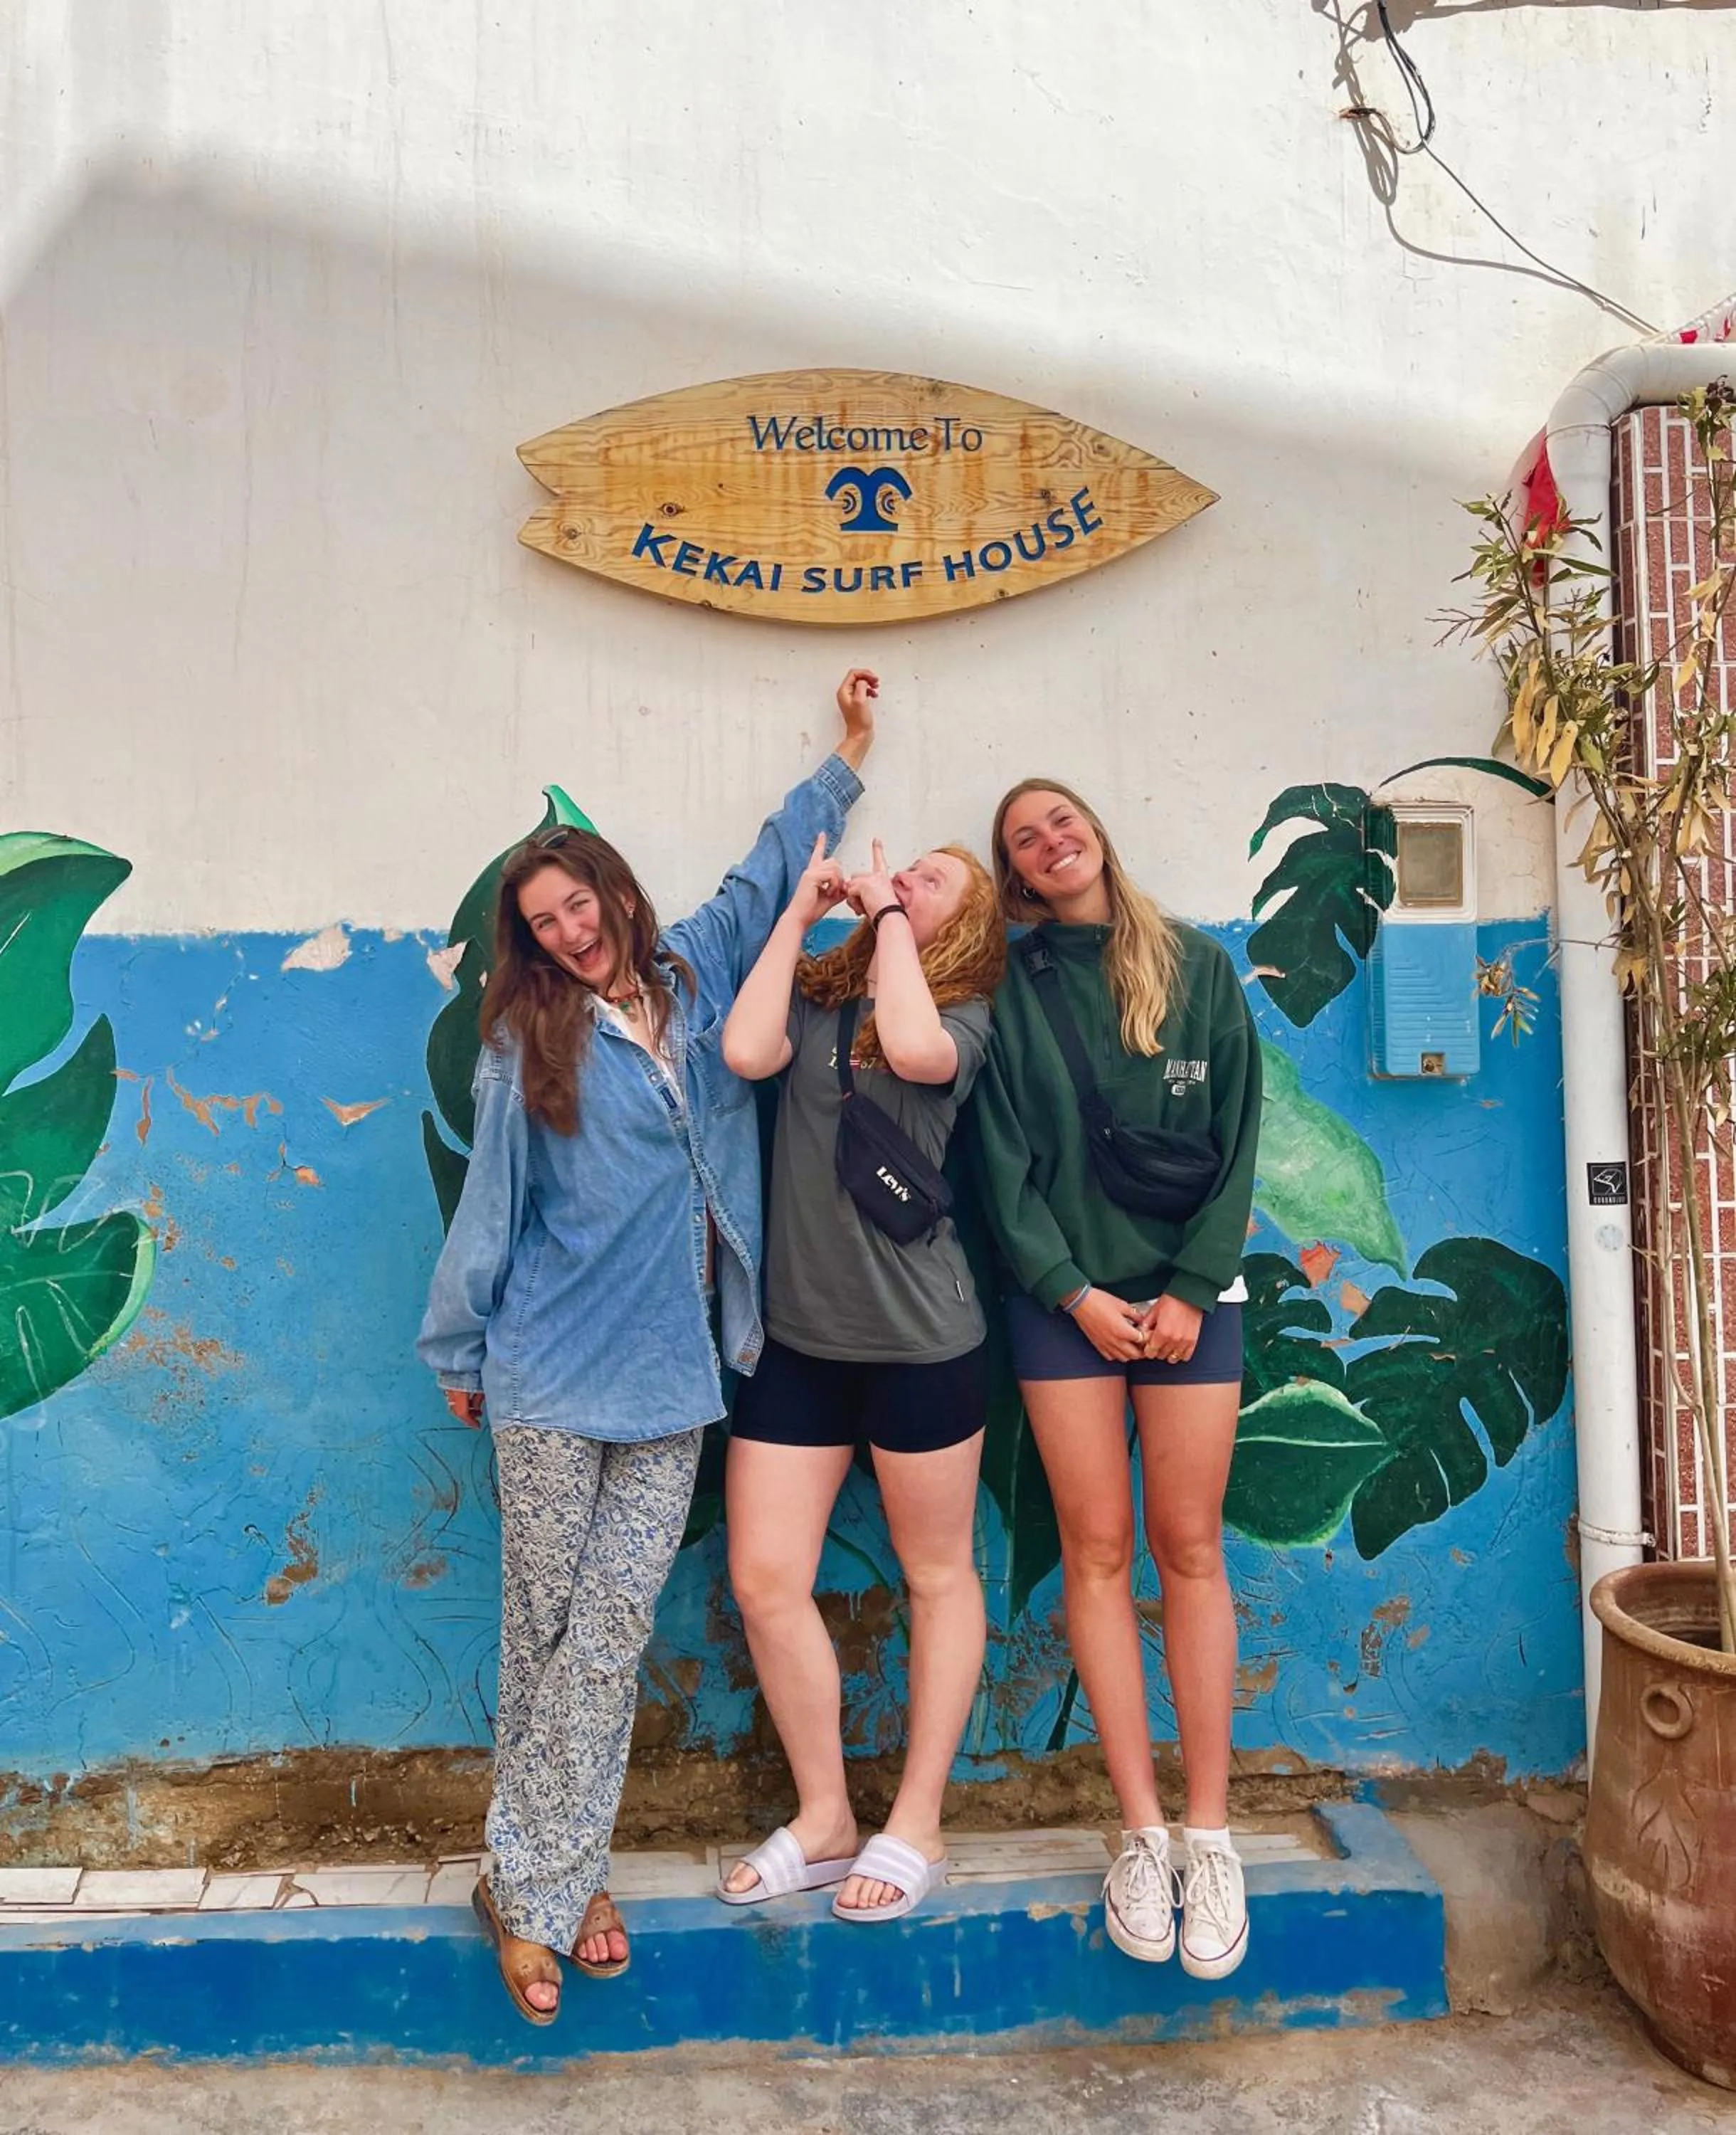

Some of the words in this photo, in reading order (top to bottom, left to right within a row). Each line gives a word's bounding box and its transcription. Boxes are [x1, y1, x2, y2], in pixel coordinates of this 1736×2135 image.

[748, 415, 928, 452] Welcome
[935, 416, 983, 452] To
[631, 523, 781, 592] KEKAI
[802, 563, 923, 594] SURF
[943, 486, 1104, 582] HOUSE
